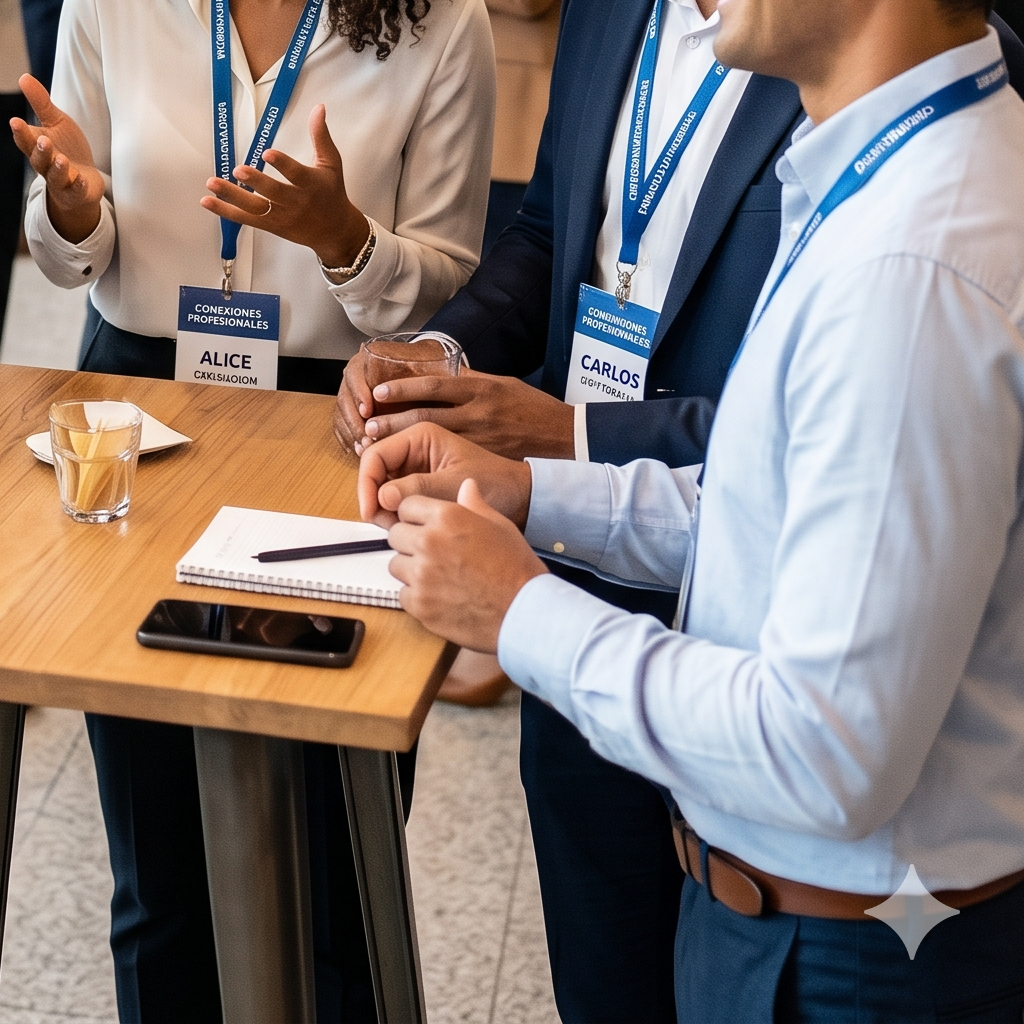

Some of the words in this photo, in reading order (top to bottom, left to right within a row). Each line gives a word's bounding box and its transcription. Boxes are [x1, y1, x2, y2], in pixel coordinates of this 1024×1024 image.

[195, 304, 262, 318] CONEXIONES
[187, 314, 269, 330] PROFESIONALES
[200, 350, 252, 370] ALICE
[581, 354, 640, 389] CARLOS
